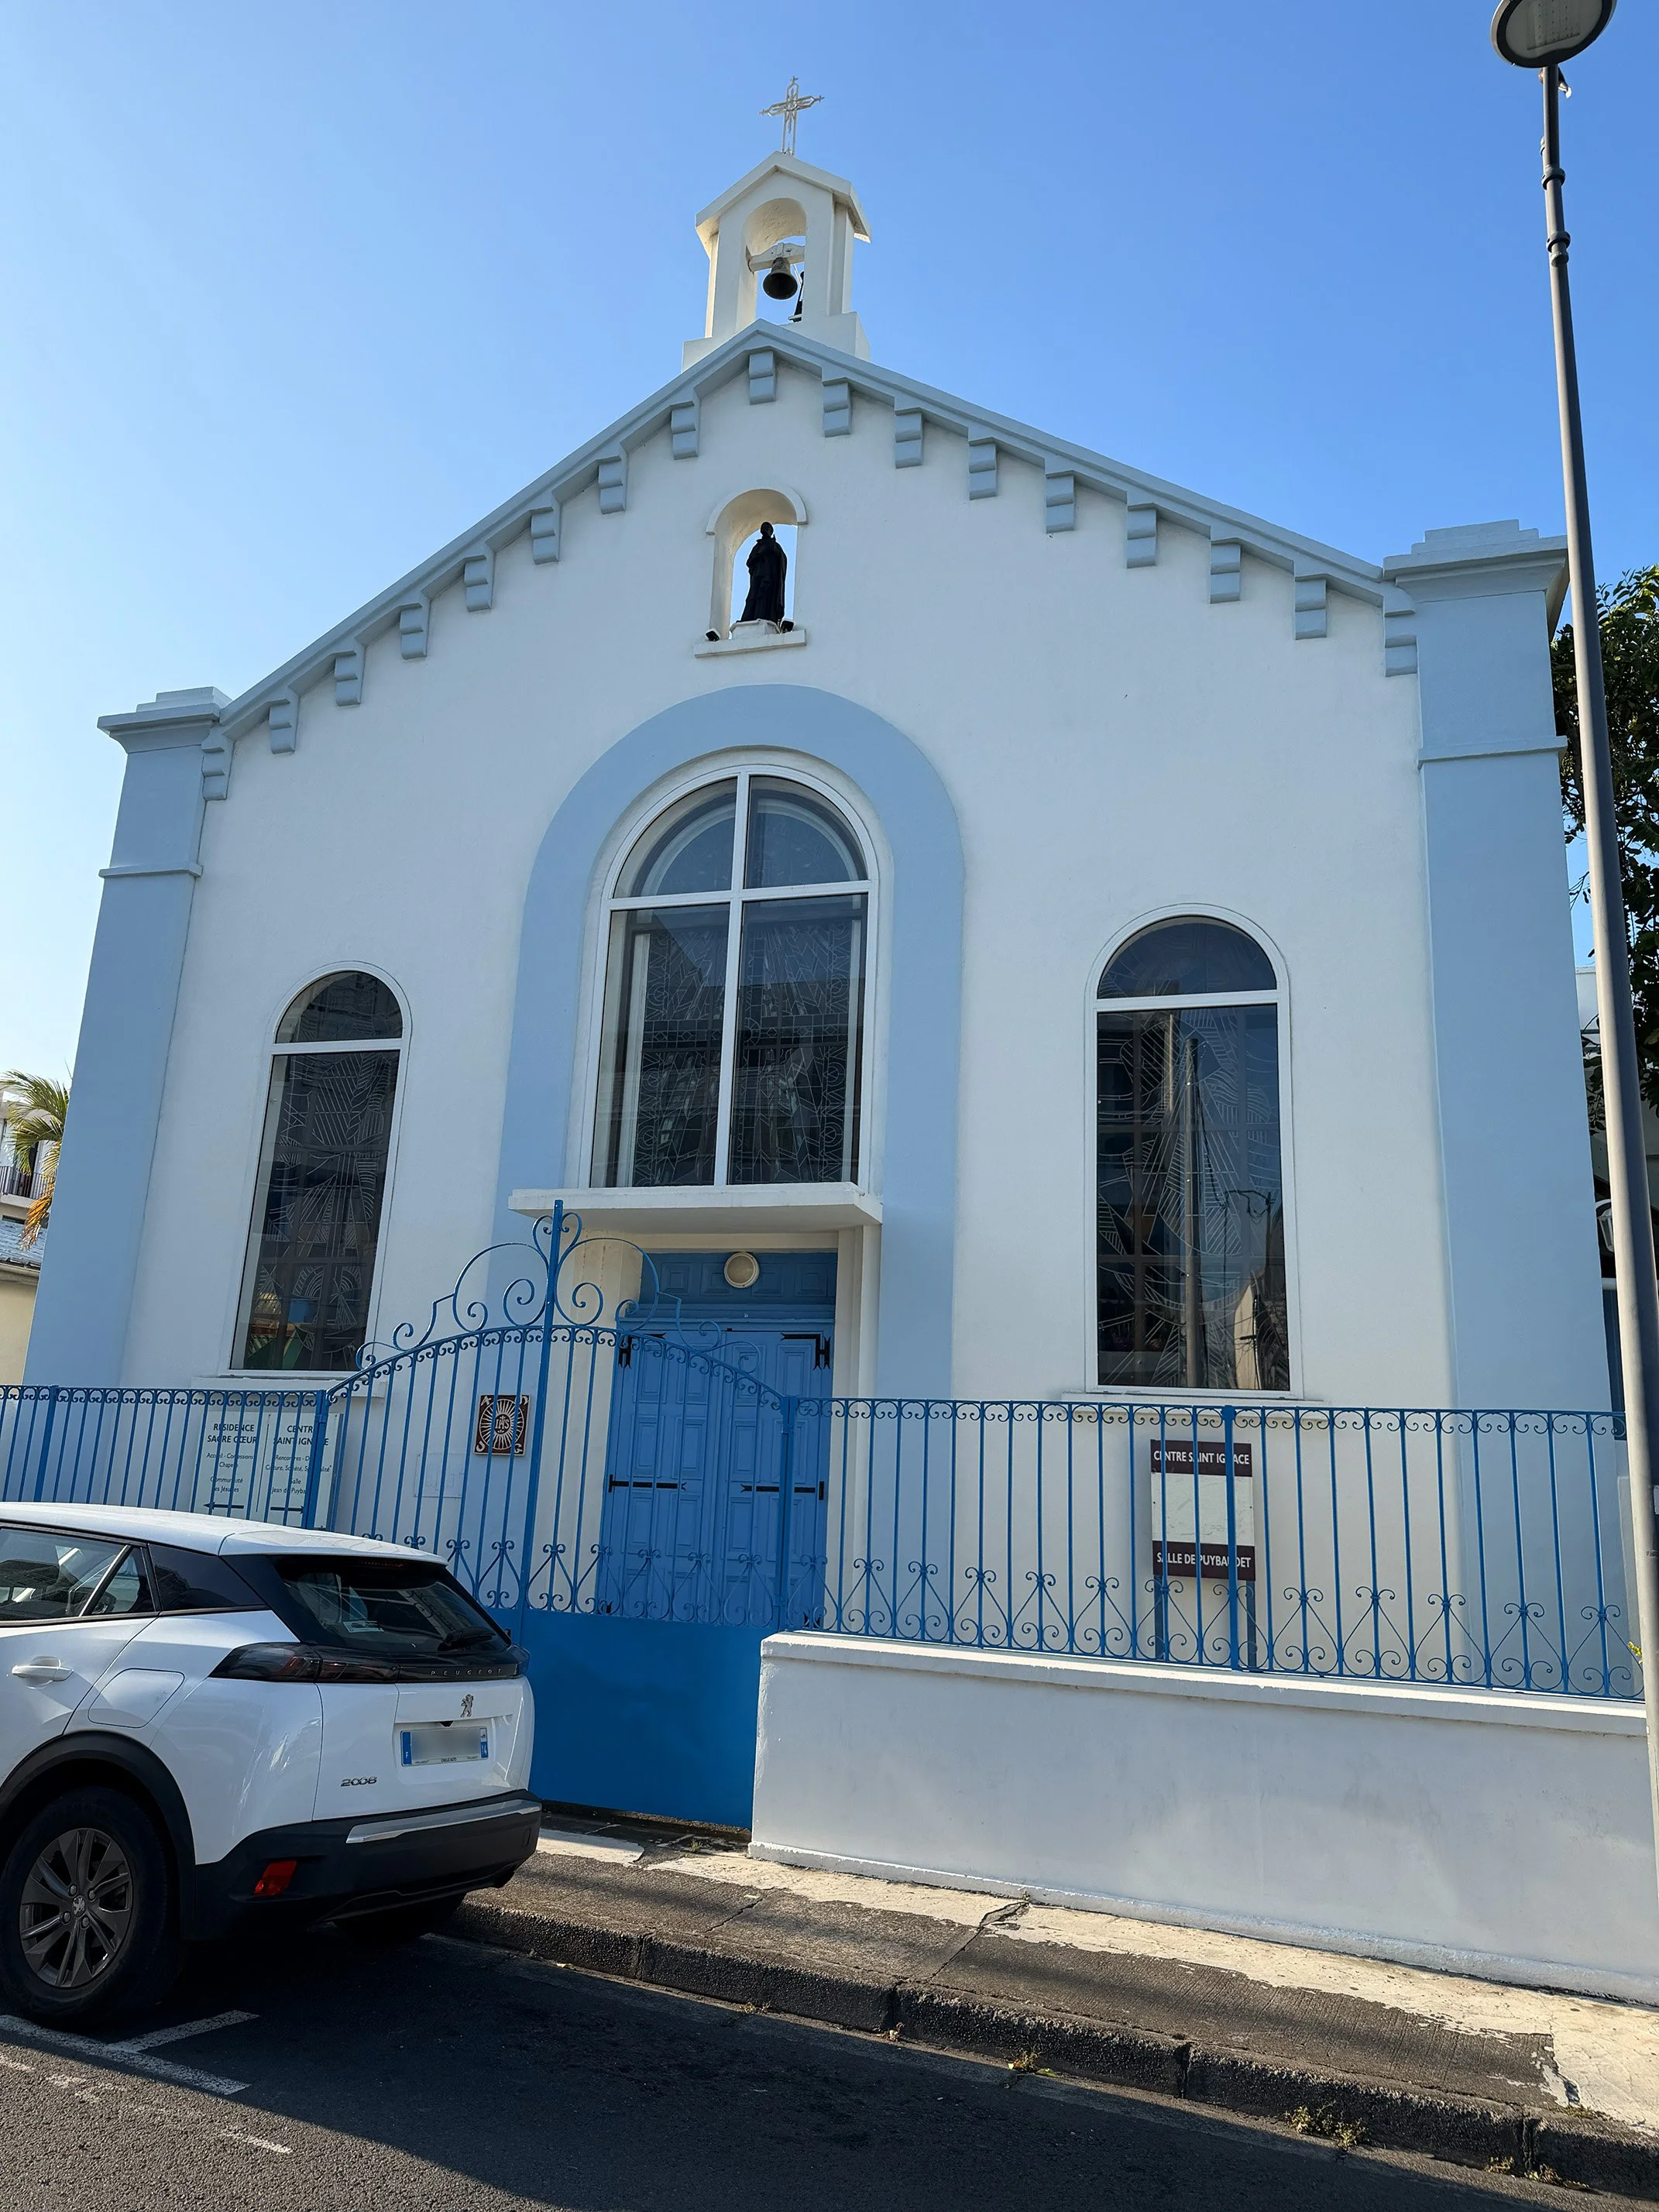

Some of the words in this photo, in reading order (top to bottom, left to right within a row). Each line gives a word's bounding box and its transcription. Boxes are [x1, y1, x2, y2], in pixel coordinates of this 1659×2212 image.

[298, 1437, 329, 1446] IGNE
[1153, 1451, 1187, 1462] CNTRE
[1216, 1453, 1249, 1465] IGACE
[1156, 1552, 1183, 1564] SLLE
[1184, 1554, 1196, 1565] DE
